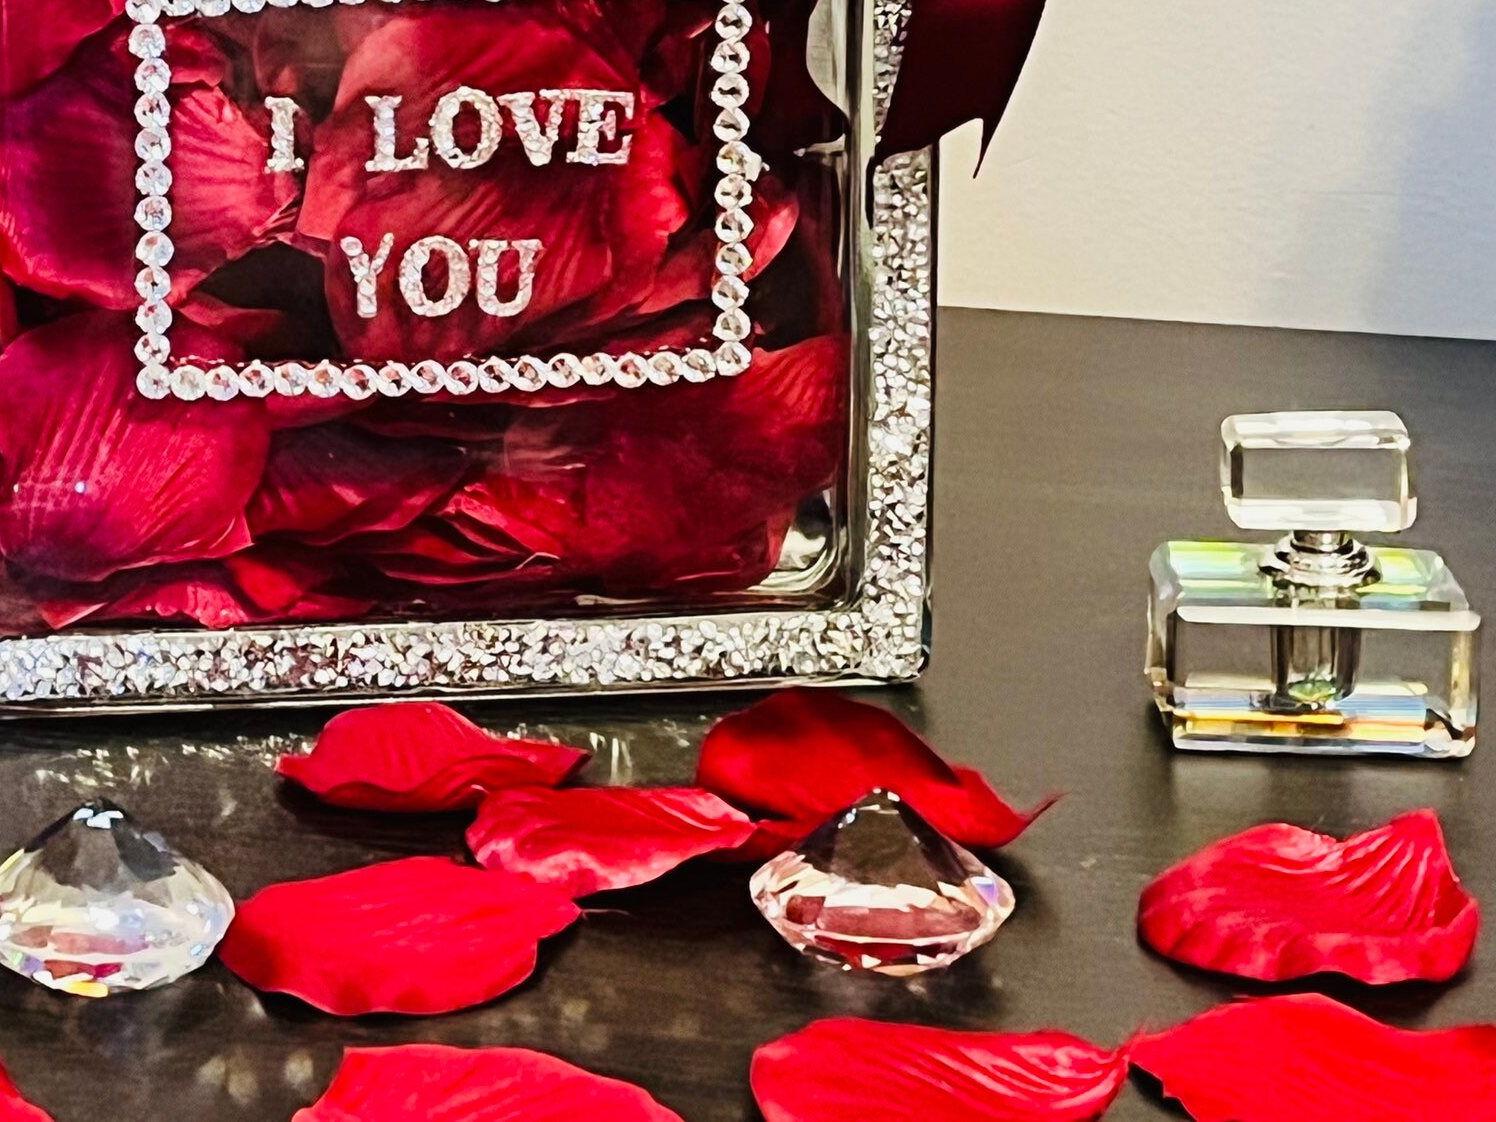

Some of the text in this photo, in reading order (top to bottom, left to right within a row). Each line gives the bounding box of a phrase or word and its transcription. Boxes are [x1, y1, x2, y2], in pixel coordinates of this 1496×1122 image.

[264, 85, 636, 175] I LOVE
[339, 232, 544, 319] YOU
